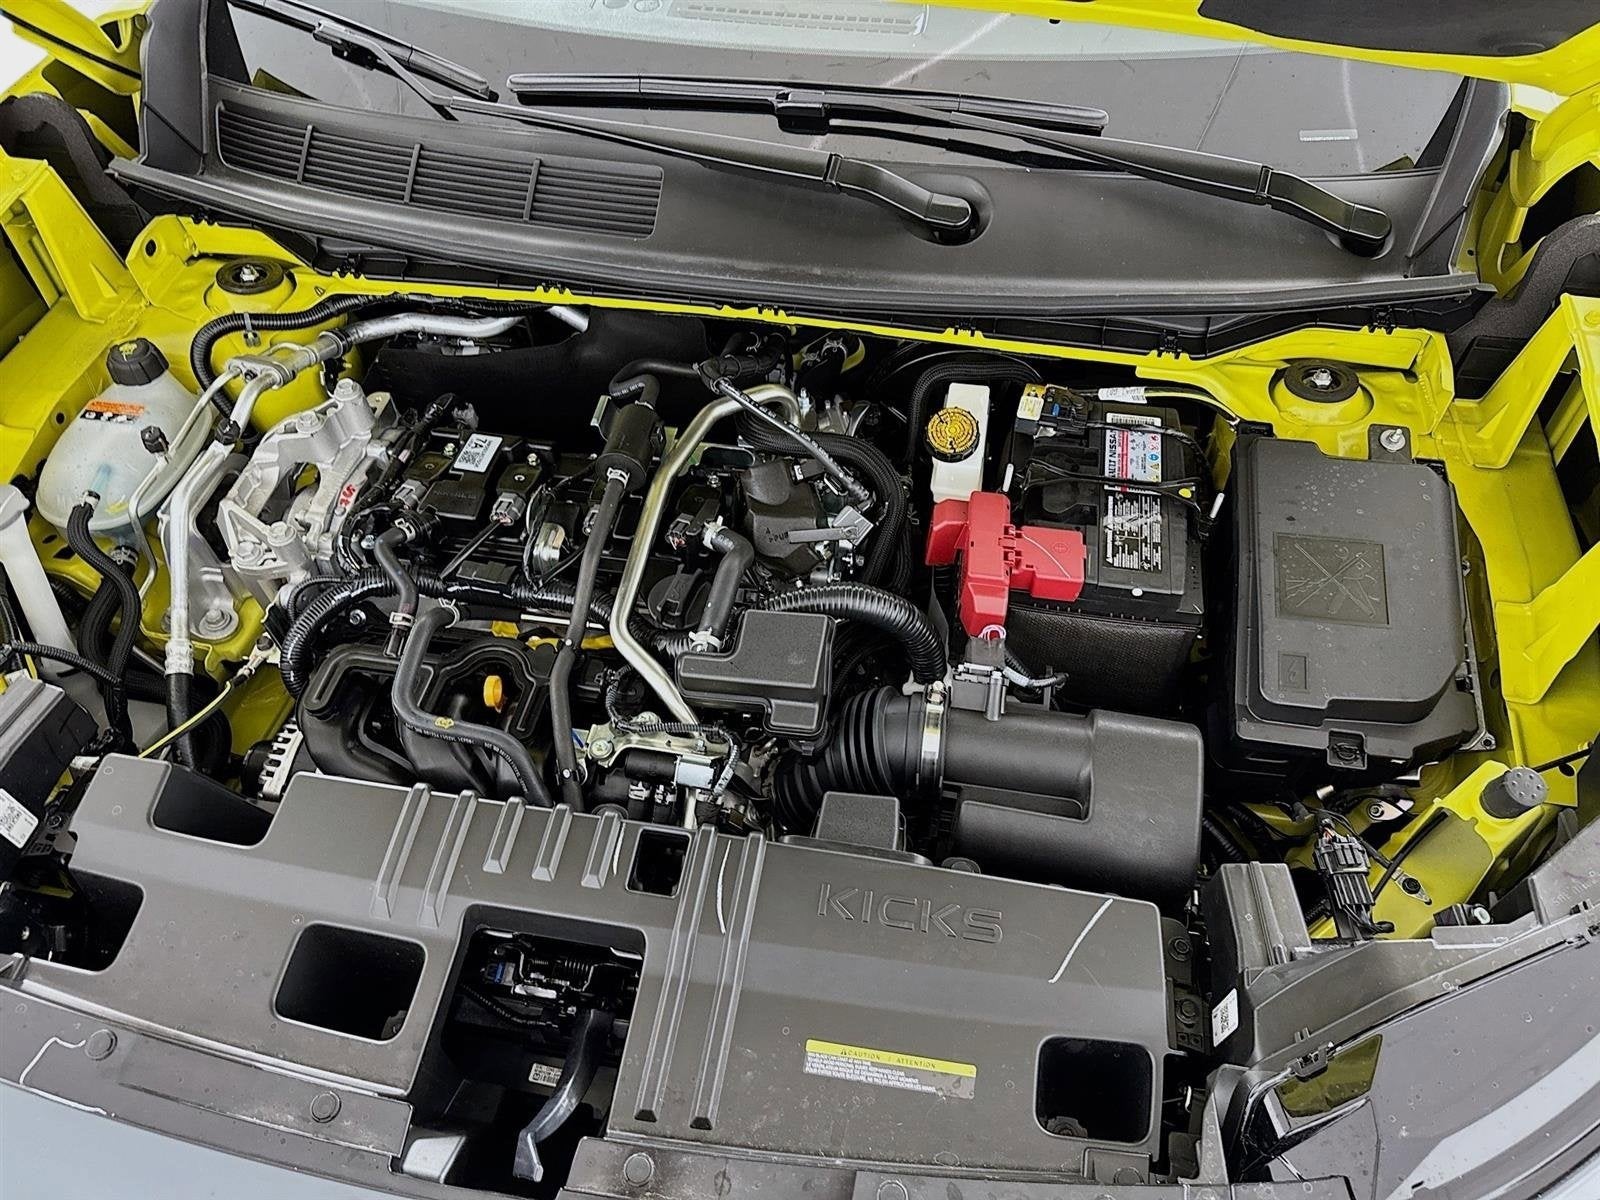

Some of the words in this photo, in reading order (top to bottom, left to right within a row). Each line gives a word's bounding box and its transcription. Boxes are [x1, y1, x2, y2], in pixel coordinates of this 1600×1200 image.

[817, 883, 1004, 944] KICKS
[847, 1049, 881, 1060] CAUTION
[896, 1057, 937, 1069] ATTENTION
